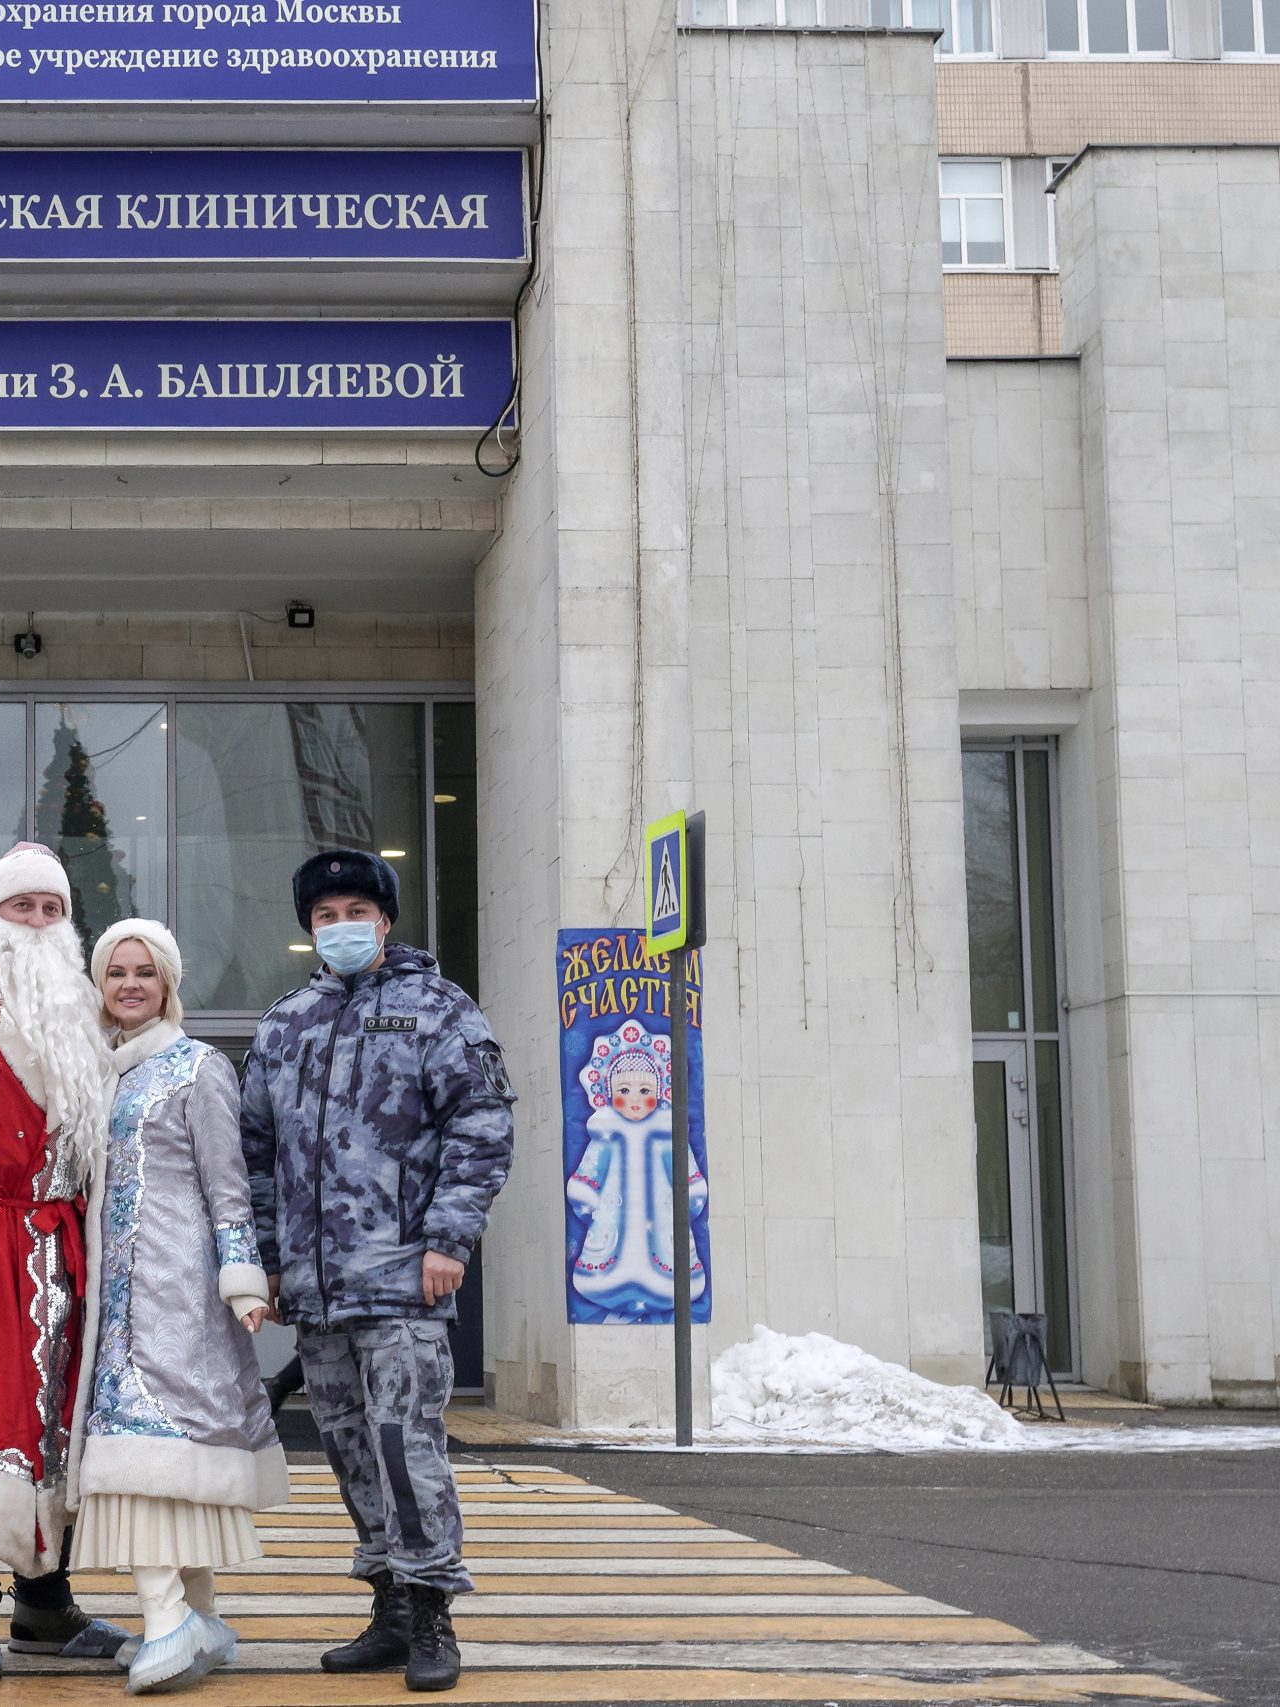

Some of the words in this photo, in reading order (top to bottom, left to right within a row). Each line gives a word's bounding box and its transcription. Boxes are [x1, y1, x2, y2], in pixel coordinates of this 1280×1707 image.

[163, 4, 268, 29] города
[275, 0, 402, 24] Москвы
[29, 48, 219, 74] учреждение
[227, 48, 498, 75] здравоохранения
[117, 194, 489, 230] КЛИНИЧЕСКАЯ
[49, 364, 89, 399] З.
[99, 364, 144, 399] А.
[157, 354, 465, 399] БАШЛЯЕВОЙ
[367, 1018, 413, 1028] ОМОН
